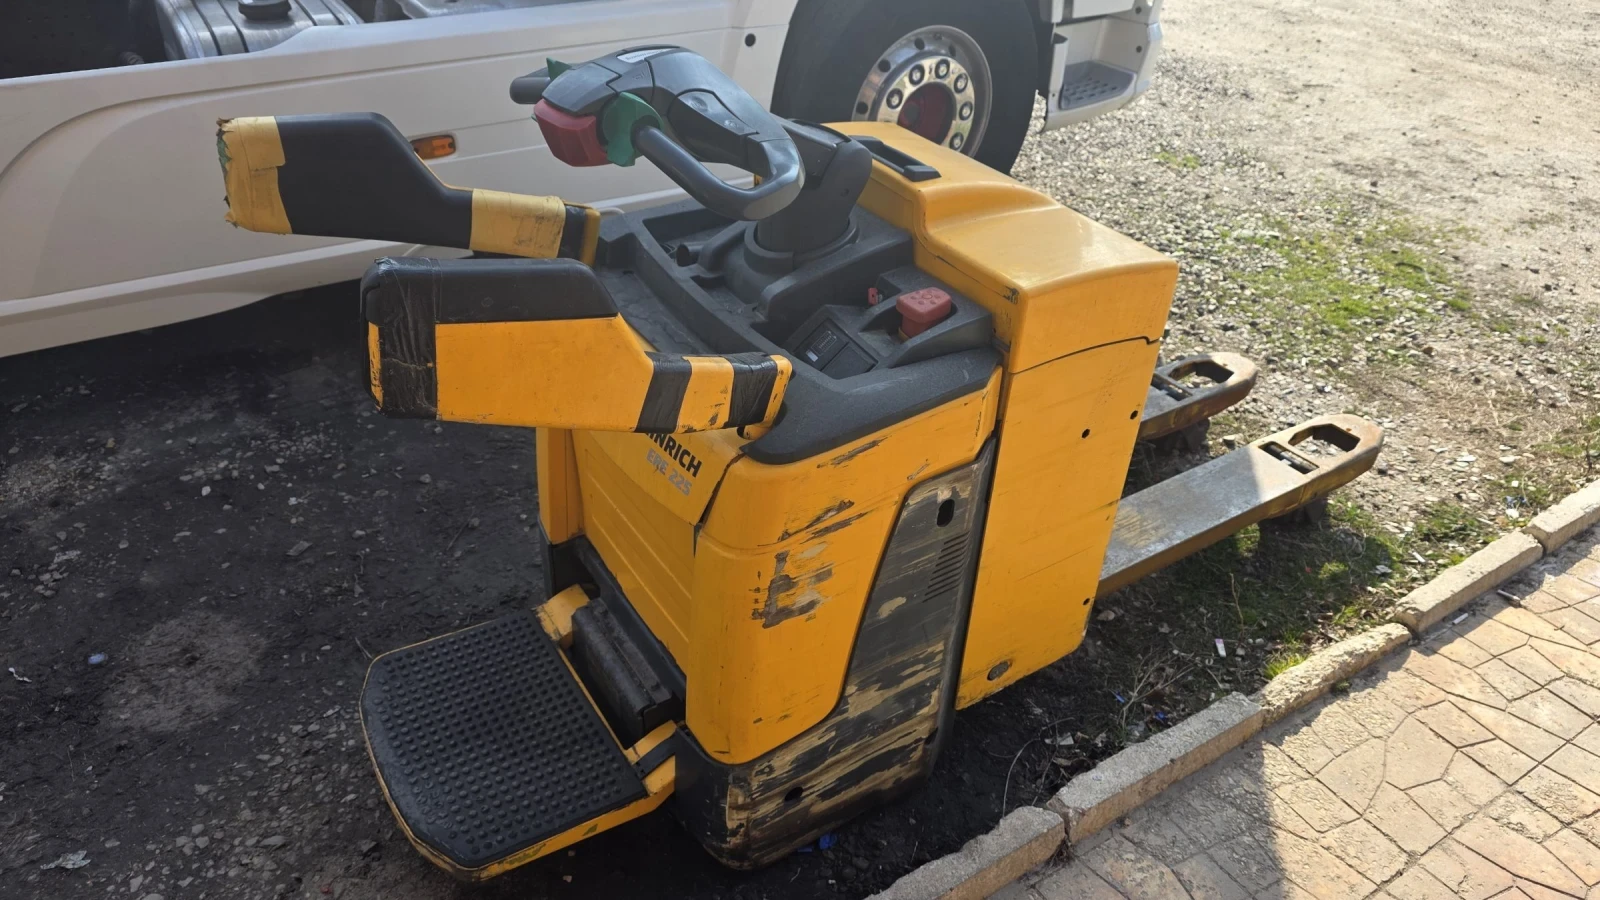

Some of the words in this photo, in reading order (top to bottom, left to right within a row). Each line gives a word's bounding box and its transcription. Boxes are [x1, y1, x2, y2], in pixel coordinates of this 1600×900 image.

[646, 432, 702, 478] NRICH
[646, 448, 668, 475] ERE
[668, 468, 692, 496] 225
